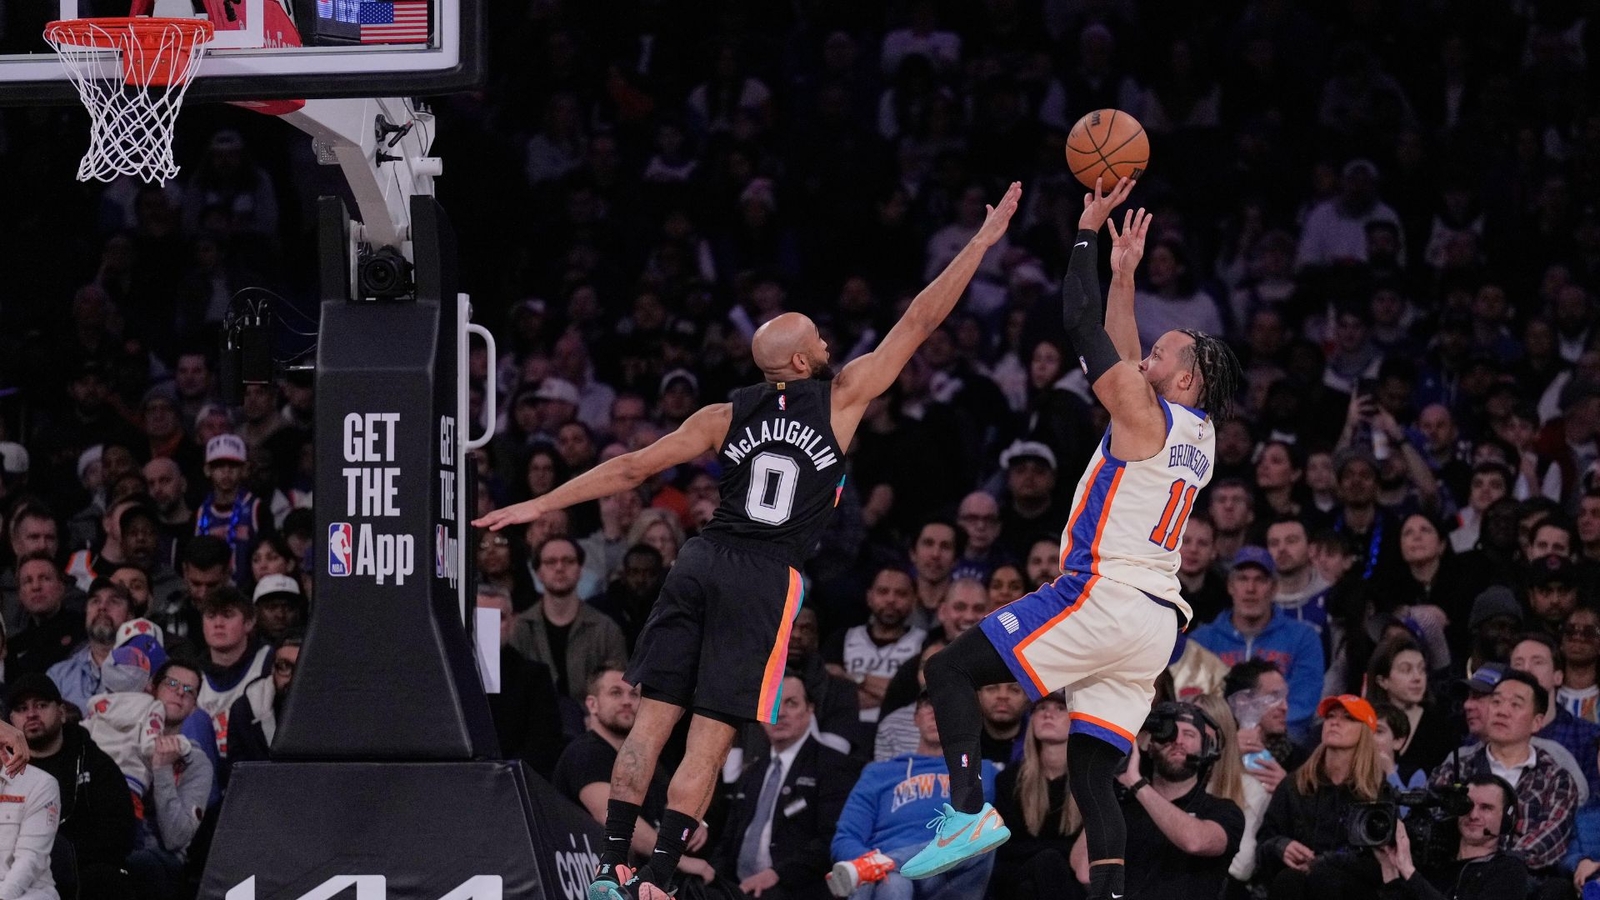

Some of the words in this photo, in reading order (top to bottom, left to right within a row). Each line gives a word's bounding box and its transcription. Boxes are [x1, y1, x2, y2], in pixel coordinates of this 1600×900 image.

[343, 412, 400, 463] GET
[440, 414, 455, 467] GET
[724, 417, 838, 472] McLAUGHLIN
[1168, 443, 1210, 481] BRUNSON
[342, 467, 400, 517] THE
[439, 470, 455, 521] THE
[744, 450, 801, 527] 0
[1148, 477, 1198, 552] 11
[355, 523, 414, 586] App
[444, 526, 458, 589] App
[891, 773, 936, 813] NEW
